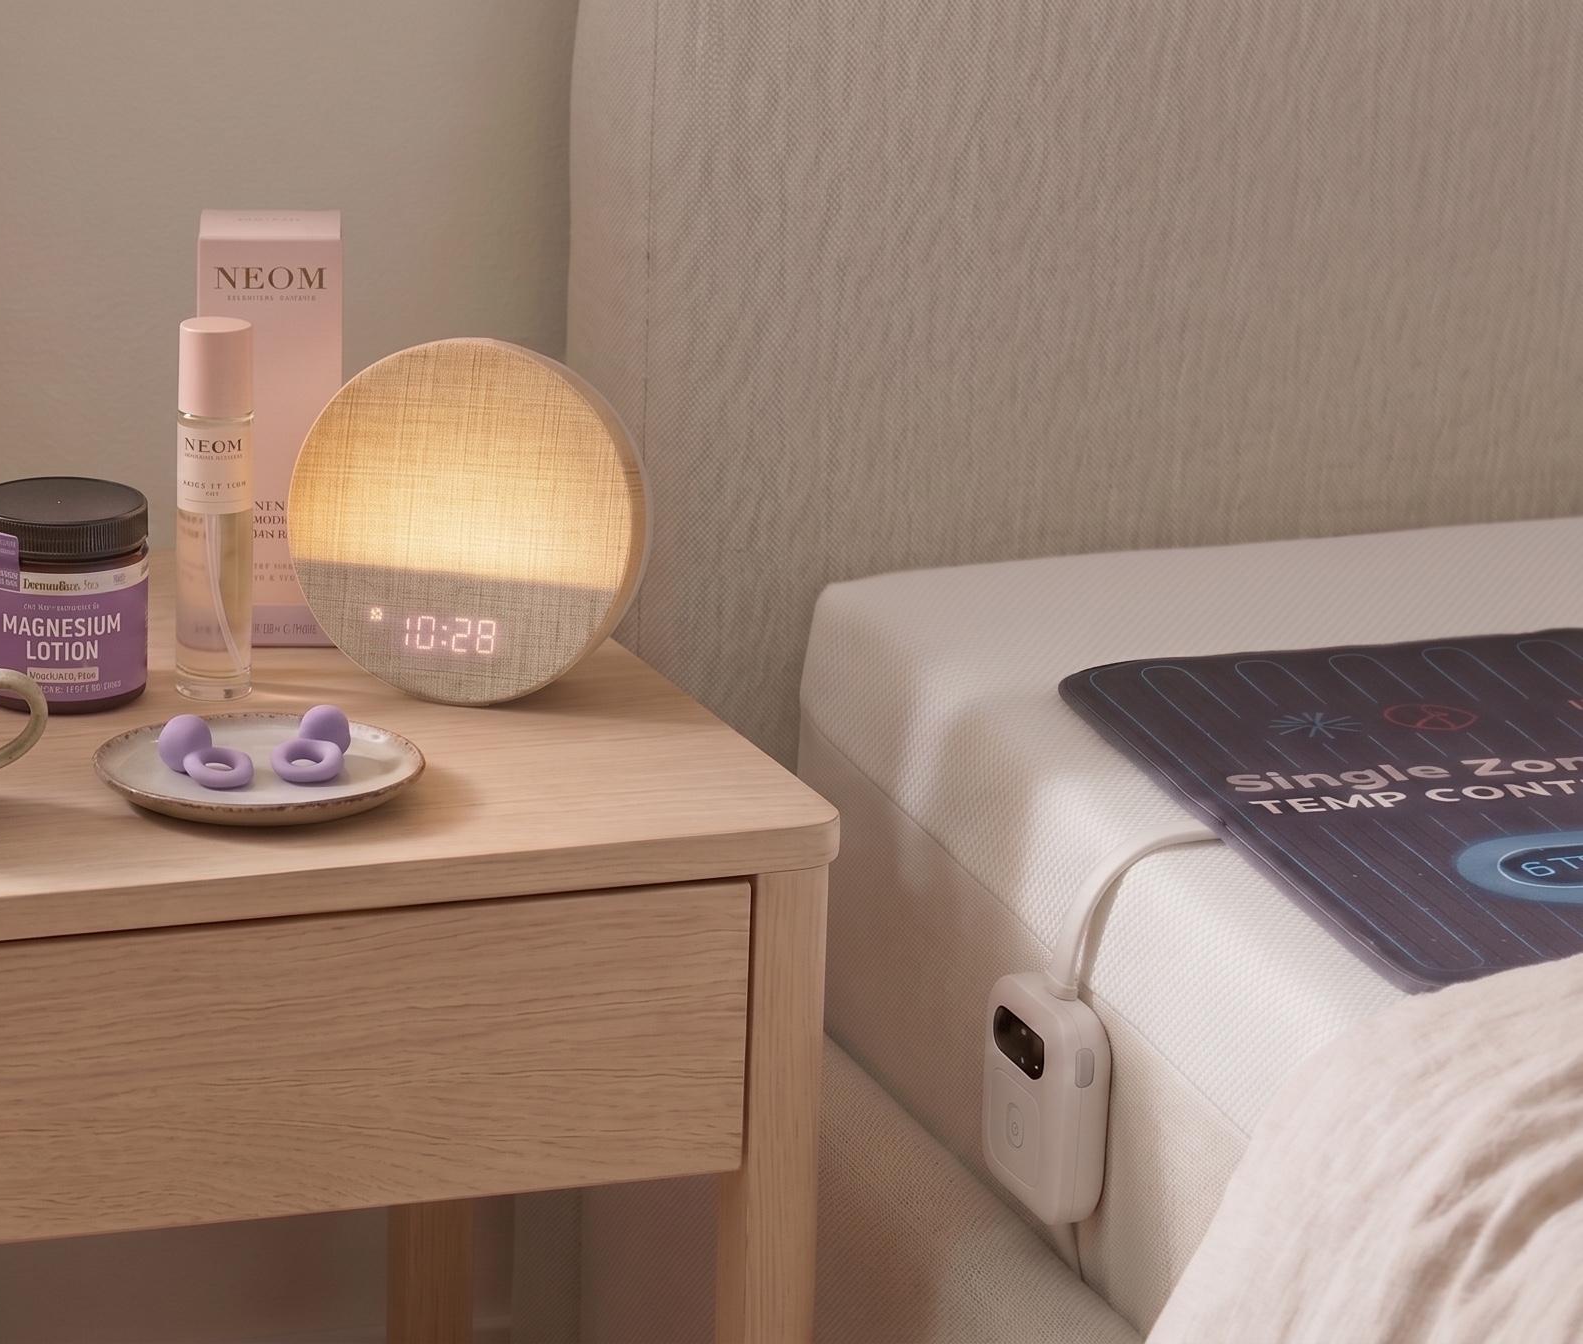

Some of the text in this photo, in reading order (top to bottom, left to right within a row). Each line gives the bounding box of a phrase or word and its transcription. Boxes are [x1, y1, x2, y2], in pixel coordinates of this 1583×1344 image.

[214, 266, 327, 290] NEOM
[185, 437, 242, 454] NEOM
[2, 612, 121, 638] MAGNESIUM
[405, 615, 496, 654] 10:28
[26, 640, 99, 661] LOTION
[1225, 764, 1451, 793] Single
[1248, 779, 1583, 814] TEMP CONT
[1521, 862, 1555, 877] 6
